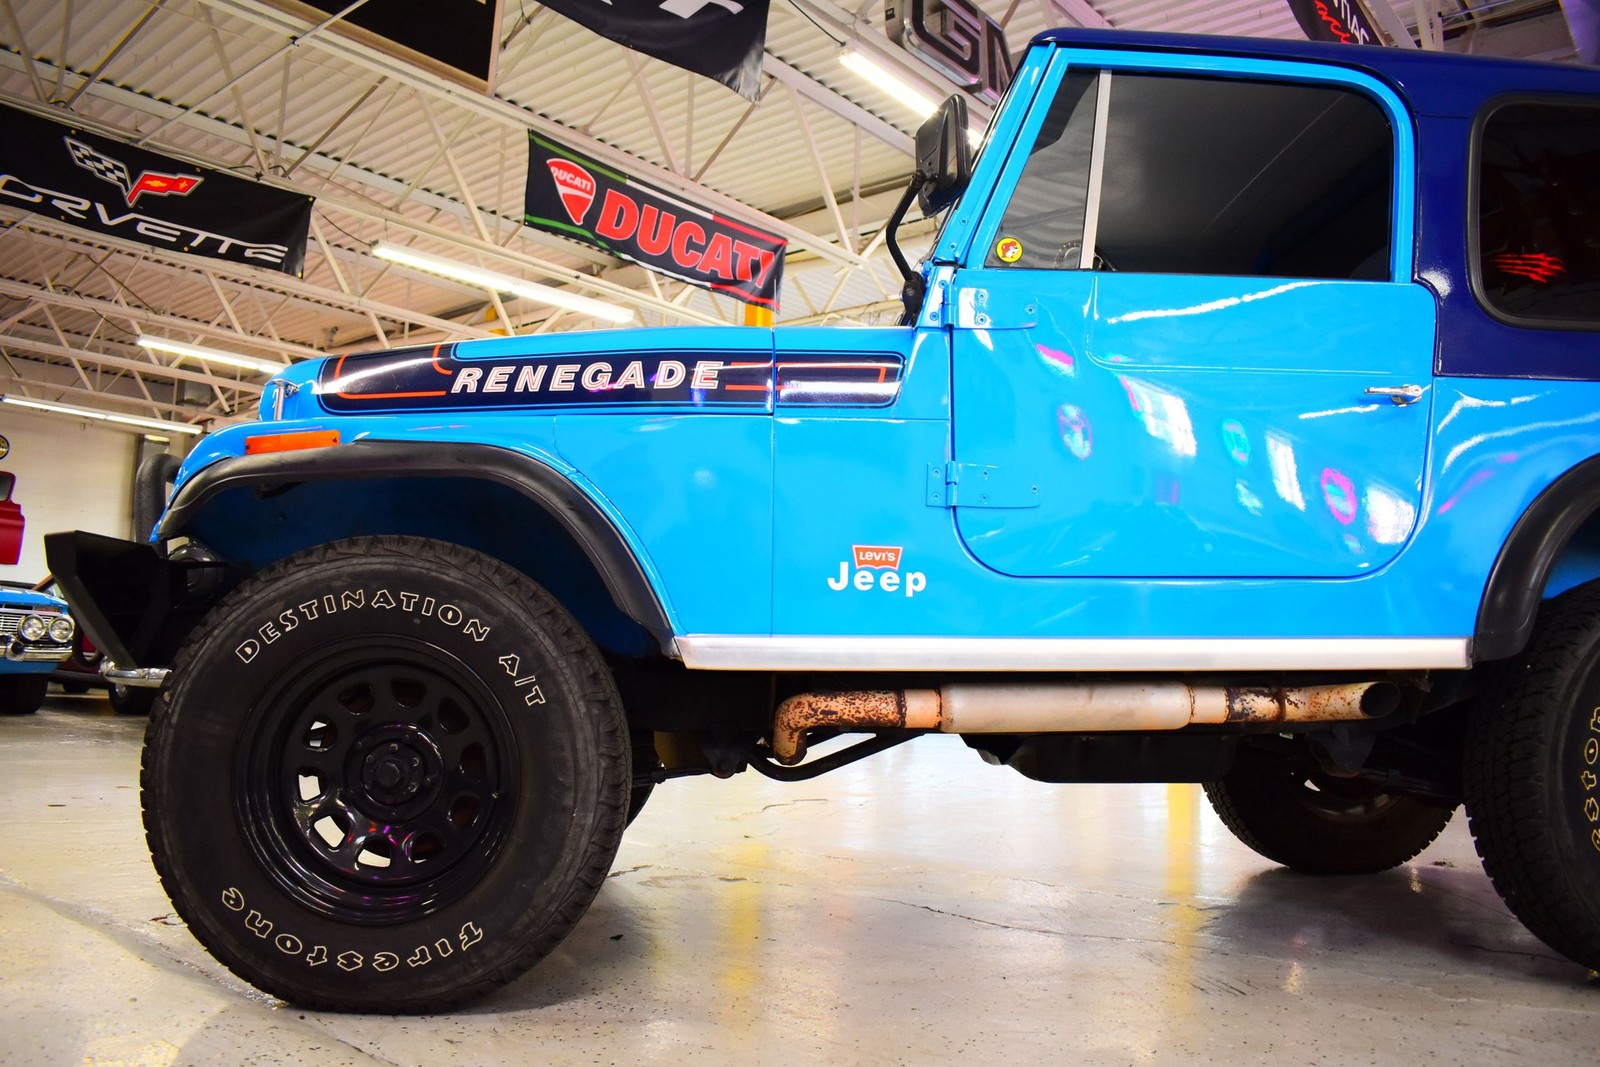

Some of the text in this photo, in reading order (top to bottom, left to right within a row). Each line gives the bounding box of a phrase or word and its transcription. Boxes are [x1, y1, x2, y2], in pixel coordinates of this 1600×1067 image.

[550, 166, 592, 192] DUCATI
[595, 188, 776, 289] DUCATI
[450, 361, 724, 394] RENEGADE
[827, 561, 927, 598] Jeep
[235, 589, 546, 707] DESTINATION A/T
[221, 887, 483, 972] Firestone
